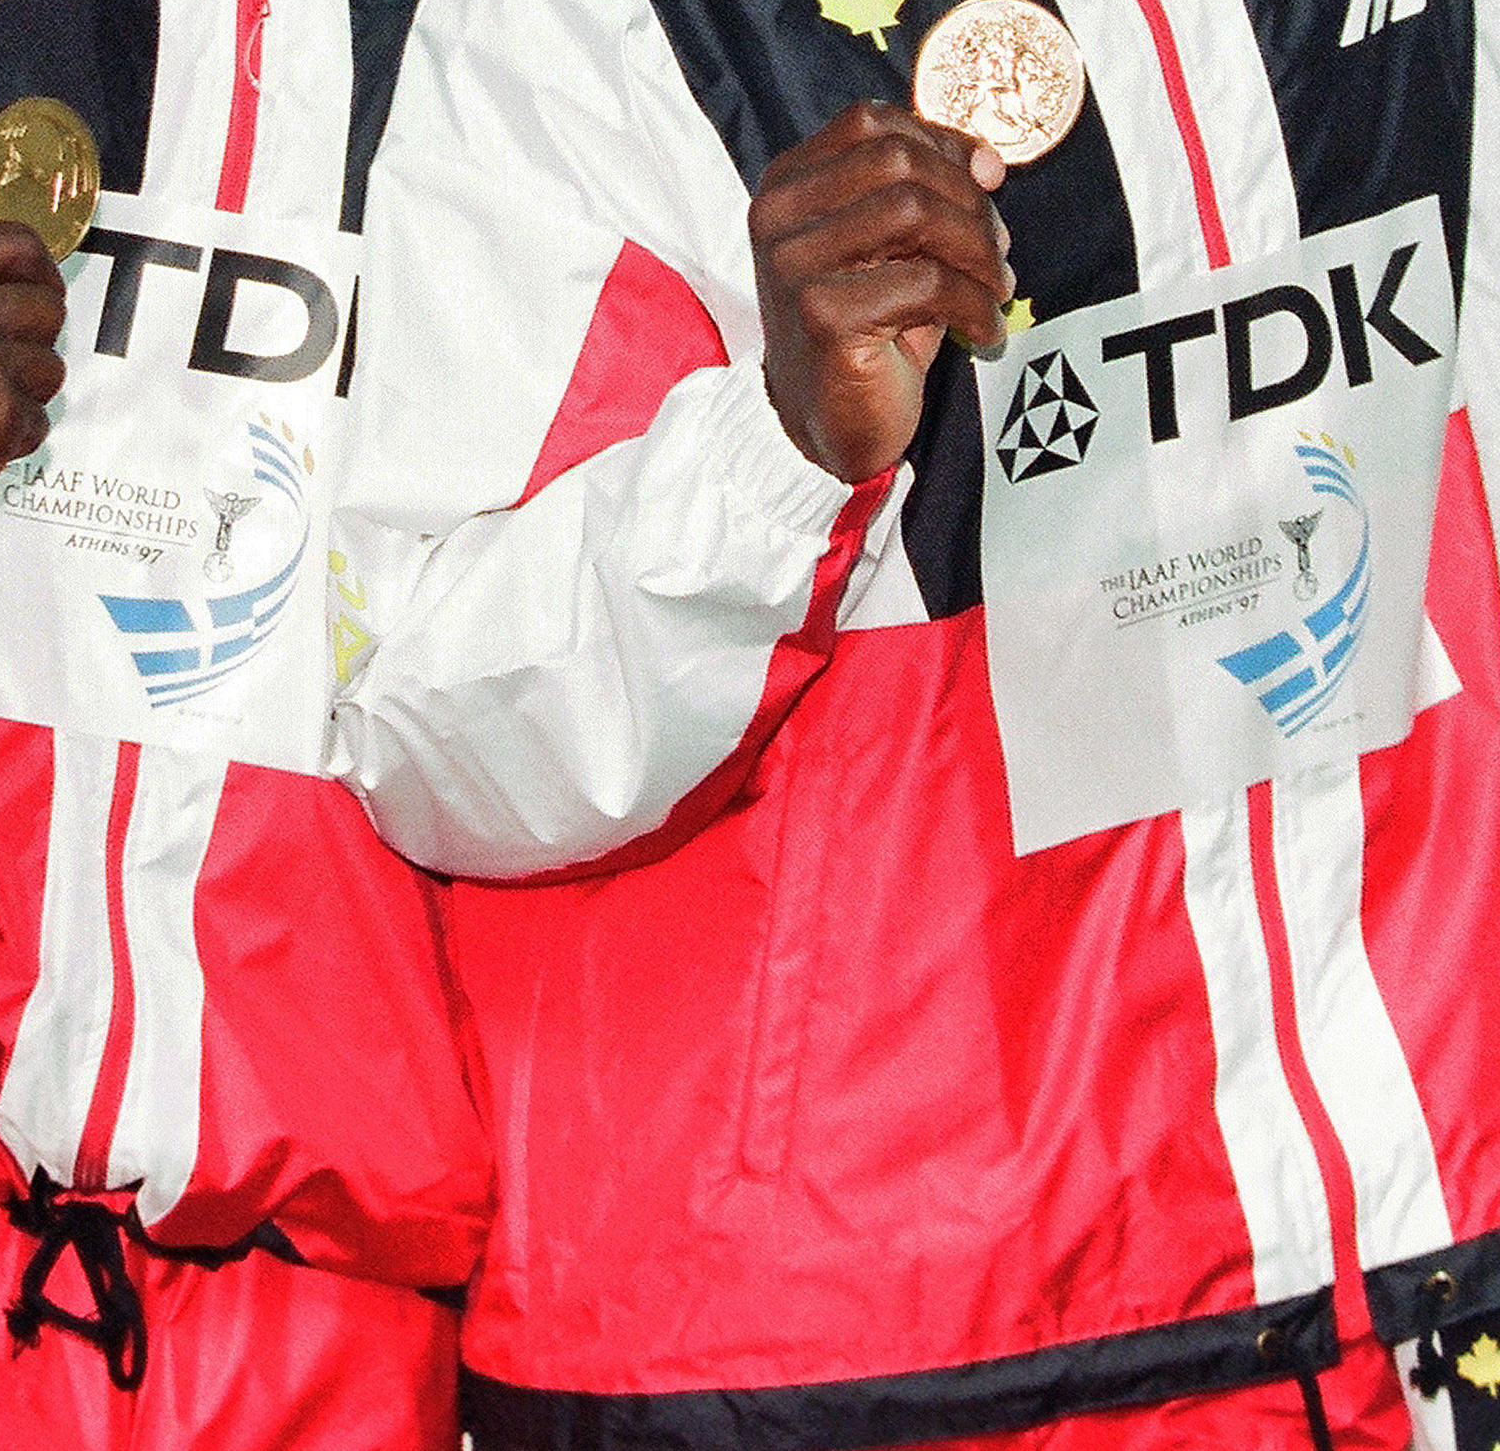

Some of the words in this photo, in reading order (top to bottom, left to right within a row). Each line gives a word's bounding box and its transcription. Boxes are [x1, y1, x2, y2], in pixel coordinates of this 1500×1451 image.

[75, 226, 360, 399] TD
[1101, 241, 1443, 444] TDK
[3, 484, 199, 539] CHAMPIONSHIPS
[22, 462, 84, 493] IAAF
[92, 474, 182, 510] WORLD
[65, 533, 131, 557] ATHENS
[1128, 557, 1180, 591] IAAF
[1187, 537, 1263, 572] WORLD
[1113, 553, 1283, 619] CHAMPIONSHIPS
